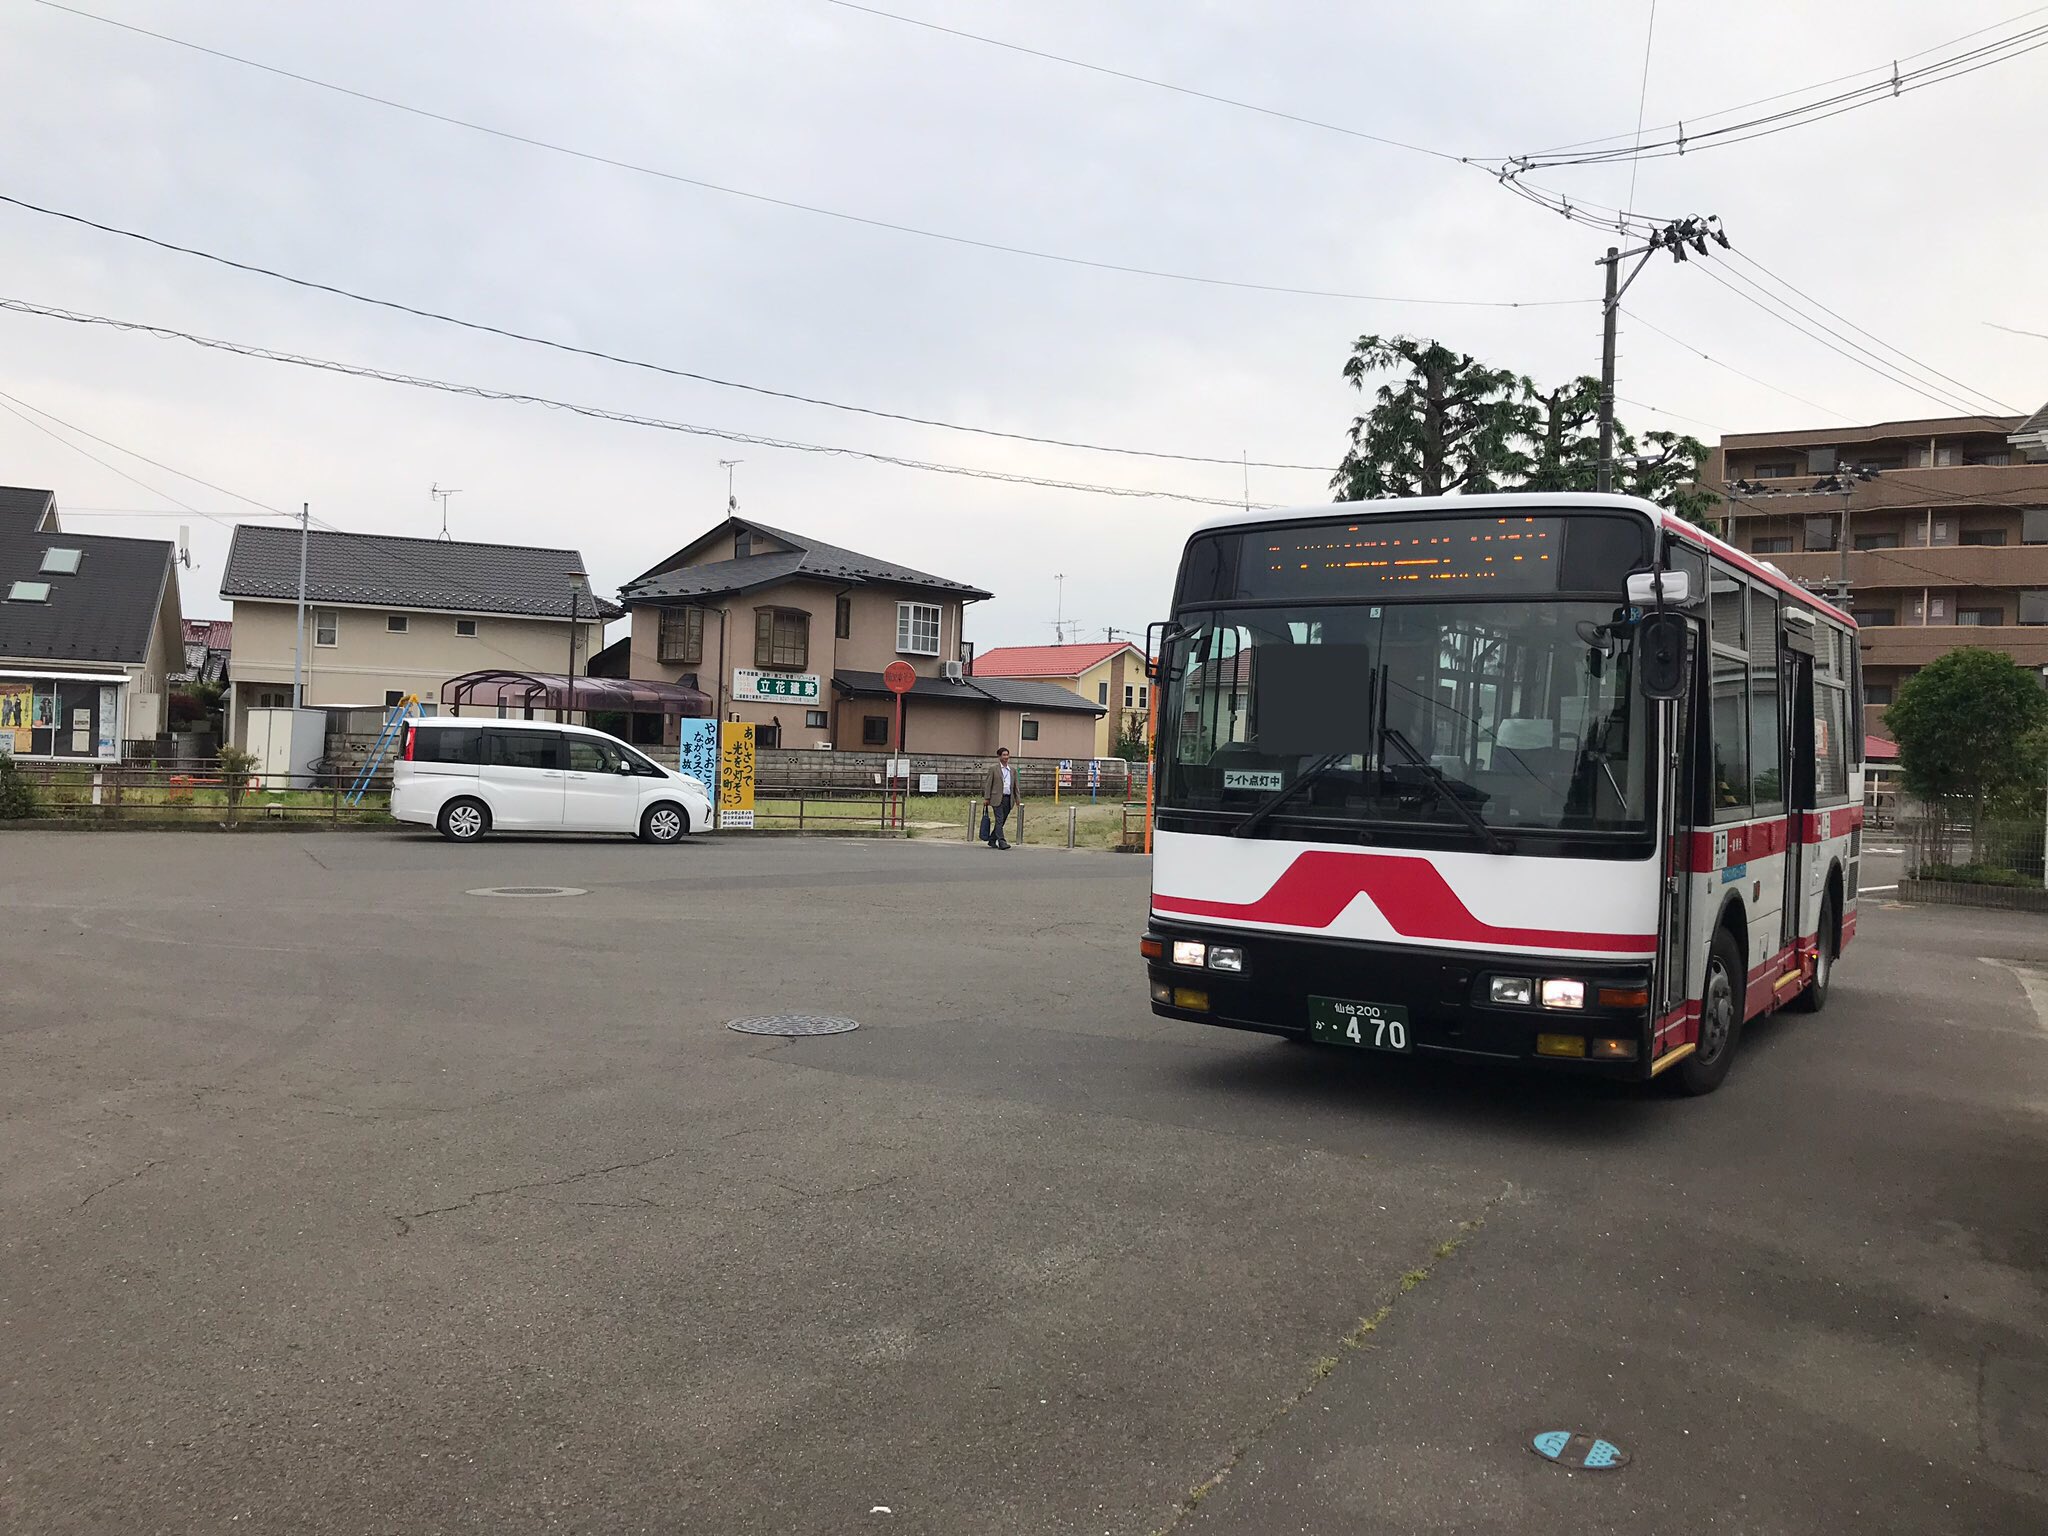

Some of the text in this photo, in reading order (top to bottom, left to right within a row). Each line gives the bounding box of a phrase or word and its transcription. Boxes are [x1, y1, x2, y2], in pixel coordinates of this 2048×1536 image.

[760, 679, 815, 696] 立花建築
[743, 726, 753, 787] あいさつで
[732, 741, 743, 804] 光を灯そう
[1225, 774, 1280, 787] ライト点灯中
[1334, 1002, 1381, 1018] 仙台200
[1315, 1020, 1326, 1030] か
